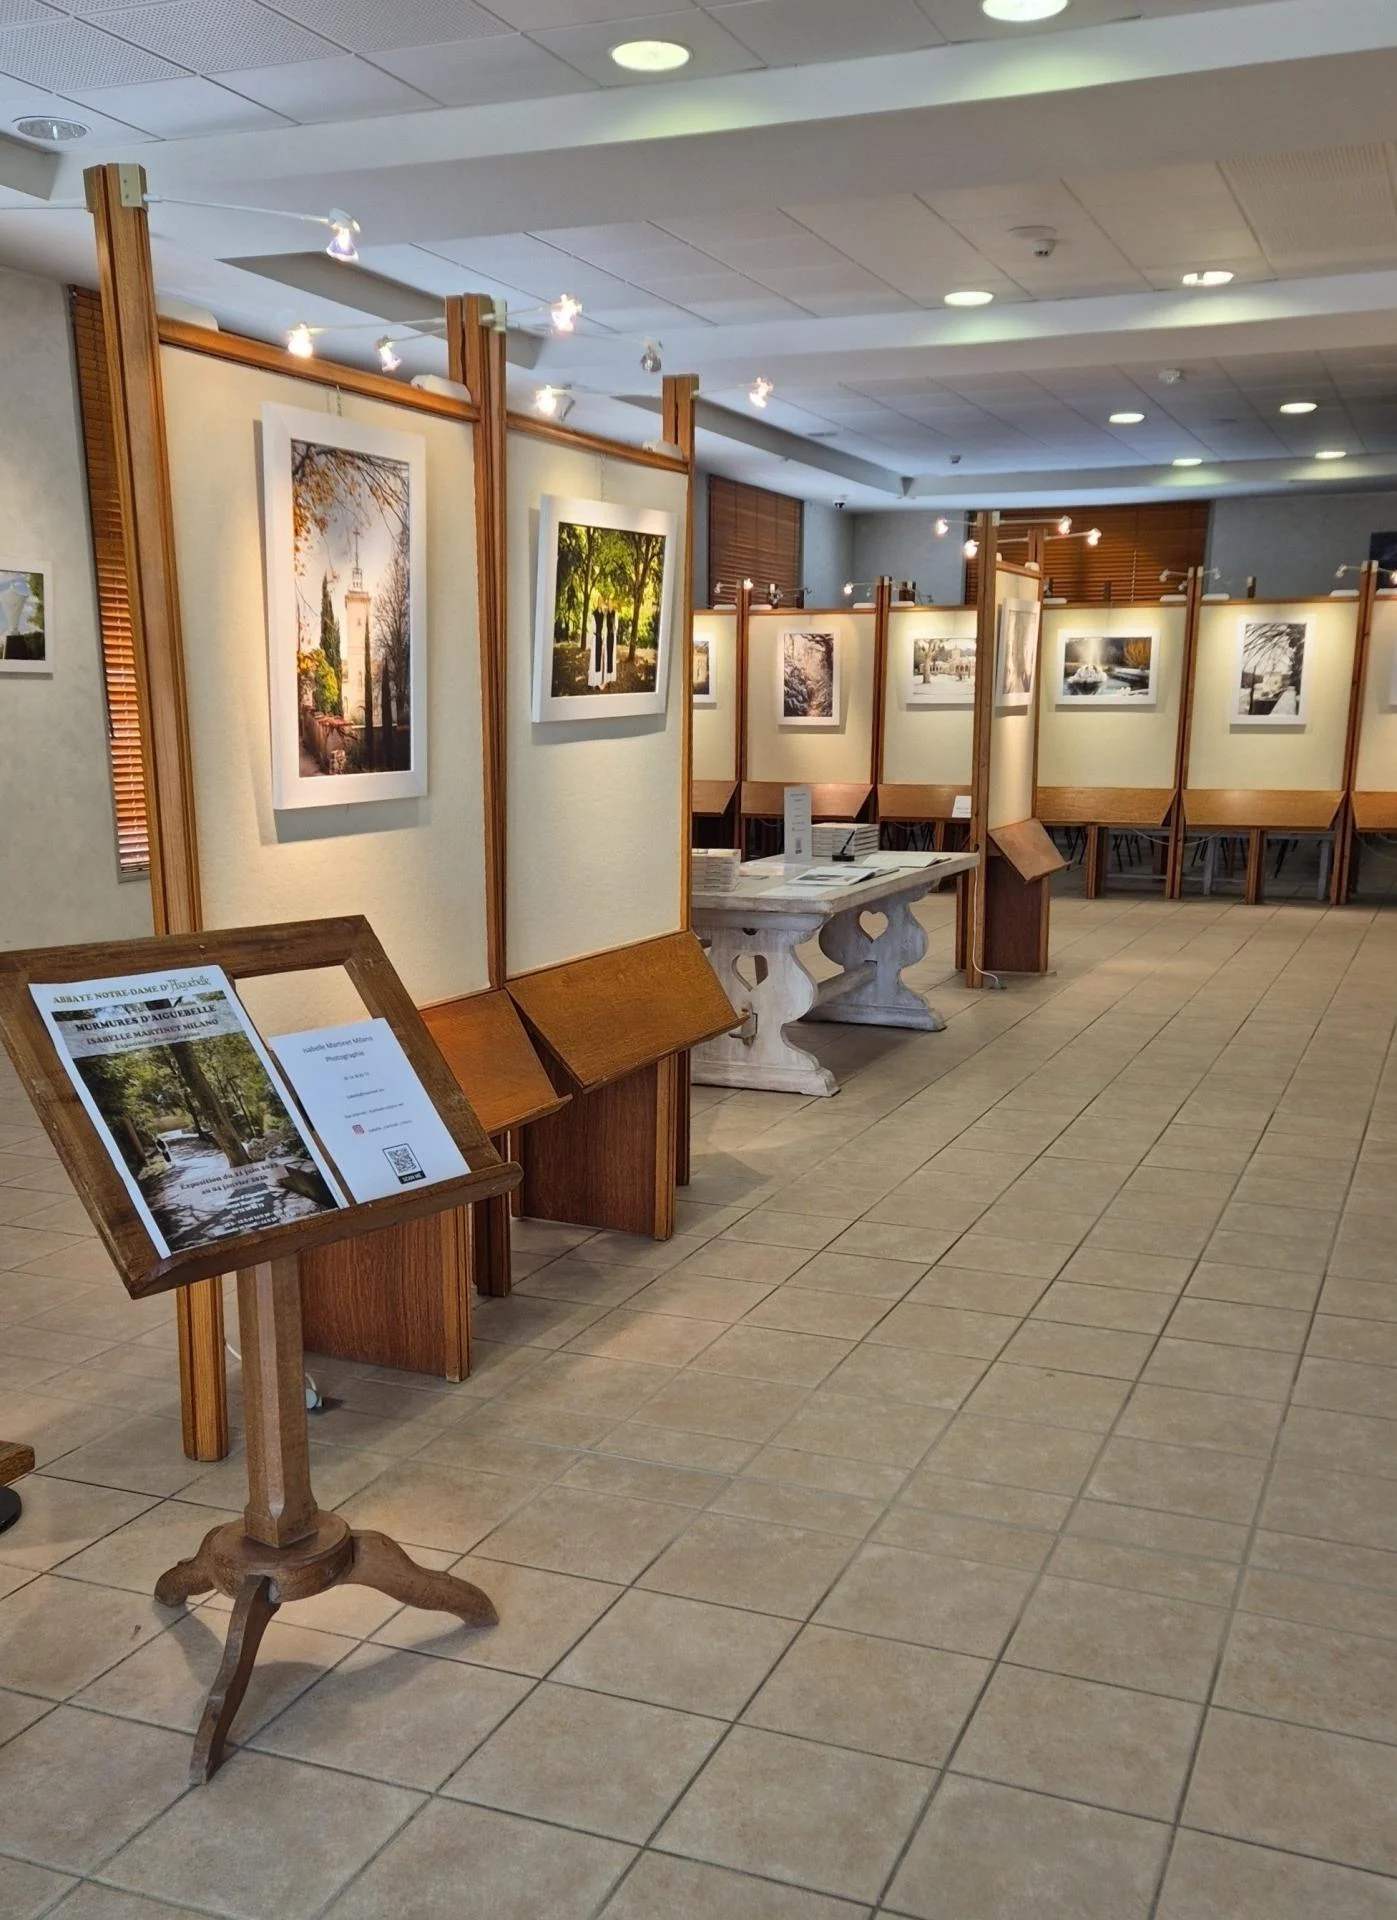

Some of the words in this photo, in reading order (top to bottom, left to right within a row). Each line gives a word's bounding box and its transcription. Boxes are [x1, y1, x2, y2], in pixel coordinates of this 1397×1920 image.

[53, 993, 93, 1004] ABBAYE
[94, 985, 159, 1000] NOTRE-DAME
[75, 1016, 139, 1032] MURMURES
[140, 1004, 217, 1023] D'AIGUEBELLE
[86, 1032, 132, 1045] ISABELLE
[132, 1025, 181, 1038] MARTINET
[183, 1018, 219, 1030] MILANO
